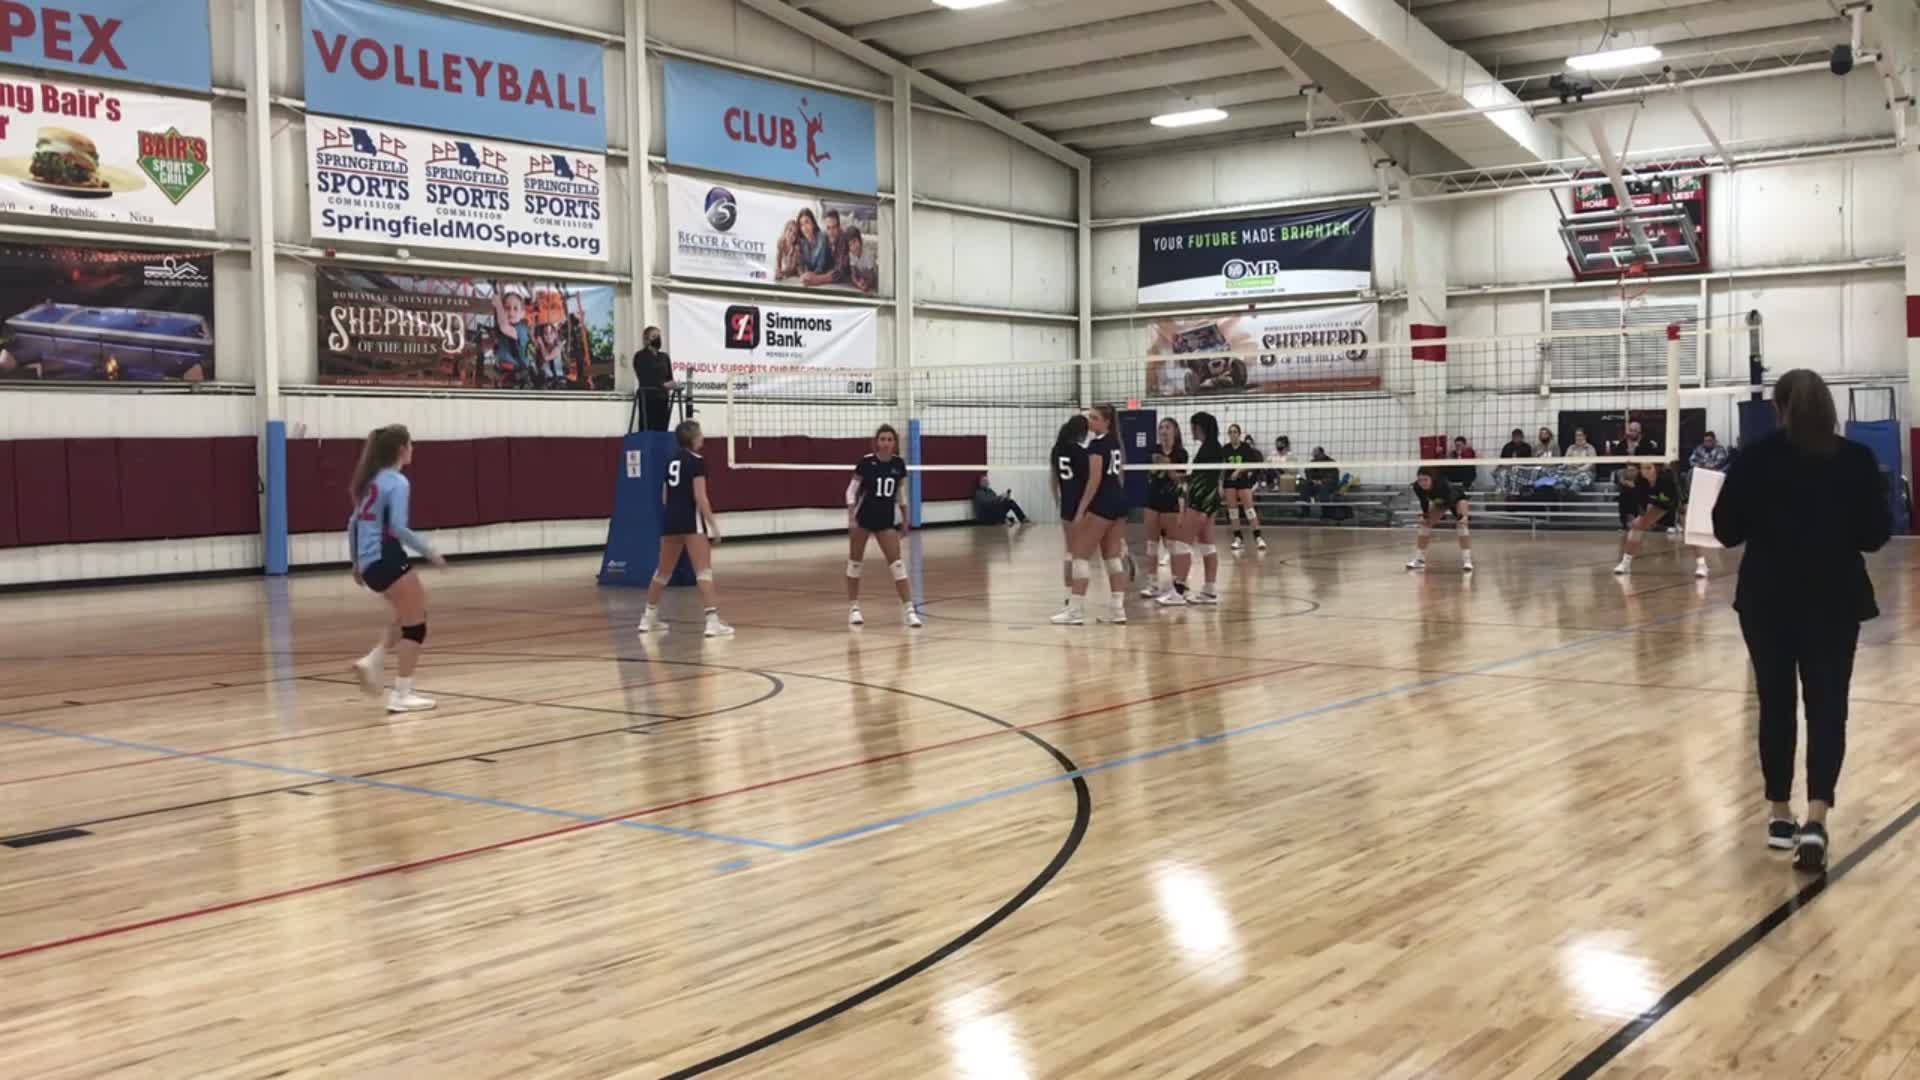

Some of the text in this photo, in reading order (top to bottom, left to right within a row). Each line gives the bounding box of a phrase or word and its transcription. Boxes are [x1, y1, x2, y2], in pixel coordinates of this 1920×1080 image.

[0, 1, 127, 70] PEX
[312, 29, 597, 115] VOLLEYBALL
[40, 83, 121, 122] Bair's
[723, 106, 797, 149] CLUB
[138, 131, 207, 163] BAIR'S
[152, 158, 195, 176] SPORTS
[316, 152, 409, 175] SPRINGFIELD
[159, 172, 188, 186] GRILL
[317, 171, 410, 201] SPORTS
[425, 166, 509, 186] SPRINGFIELD
[523, 178, 600, 196] SPRINGFIELD
[328, 196, 401, 210] COMMISSION
[426, 183, 510, 212] SPORTS
[525, 194, 601, 220] SPORTS
[1582, 198, 1609, 208] HOME
[50, 203, 98, 218] Republic
[436, 207, 502, 220] COMMISSION
[322, 208, 600, 254] SpringfieldMOSports.org
[533, 218, 593, 229] COMMISSION
[678, 230, 719, 247] BECKER
[731, 237, 765, 252] SCOTT
[1152, 221, 1356, 251] YOUR FUTURE MADE BRIGHTER.
[1224, 260, 1278, 279] OMB
[328, 305, 465, 353] SHEPHERD
[765, 311, 832, 332] Simmons
[358, 341, 437, 353] OF THE HILLS
[765, 330, 803, 348] Bank
[1260, 329, 1368, 366] SHEPHERD
[672, 362, 718, 373] PROUDLY
[720, 364, 768, 374] SUPPORTS
[1058, 456, 1073, 480] 5
[1106, 449, 1121, 475] 18
[668, 460, 681, 487] 9
[876, 477, 895, 497] 10
